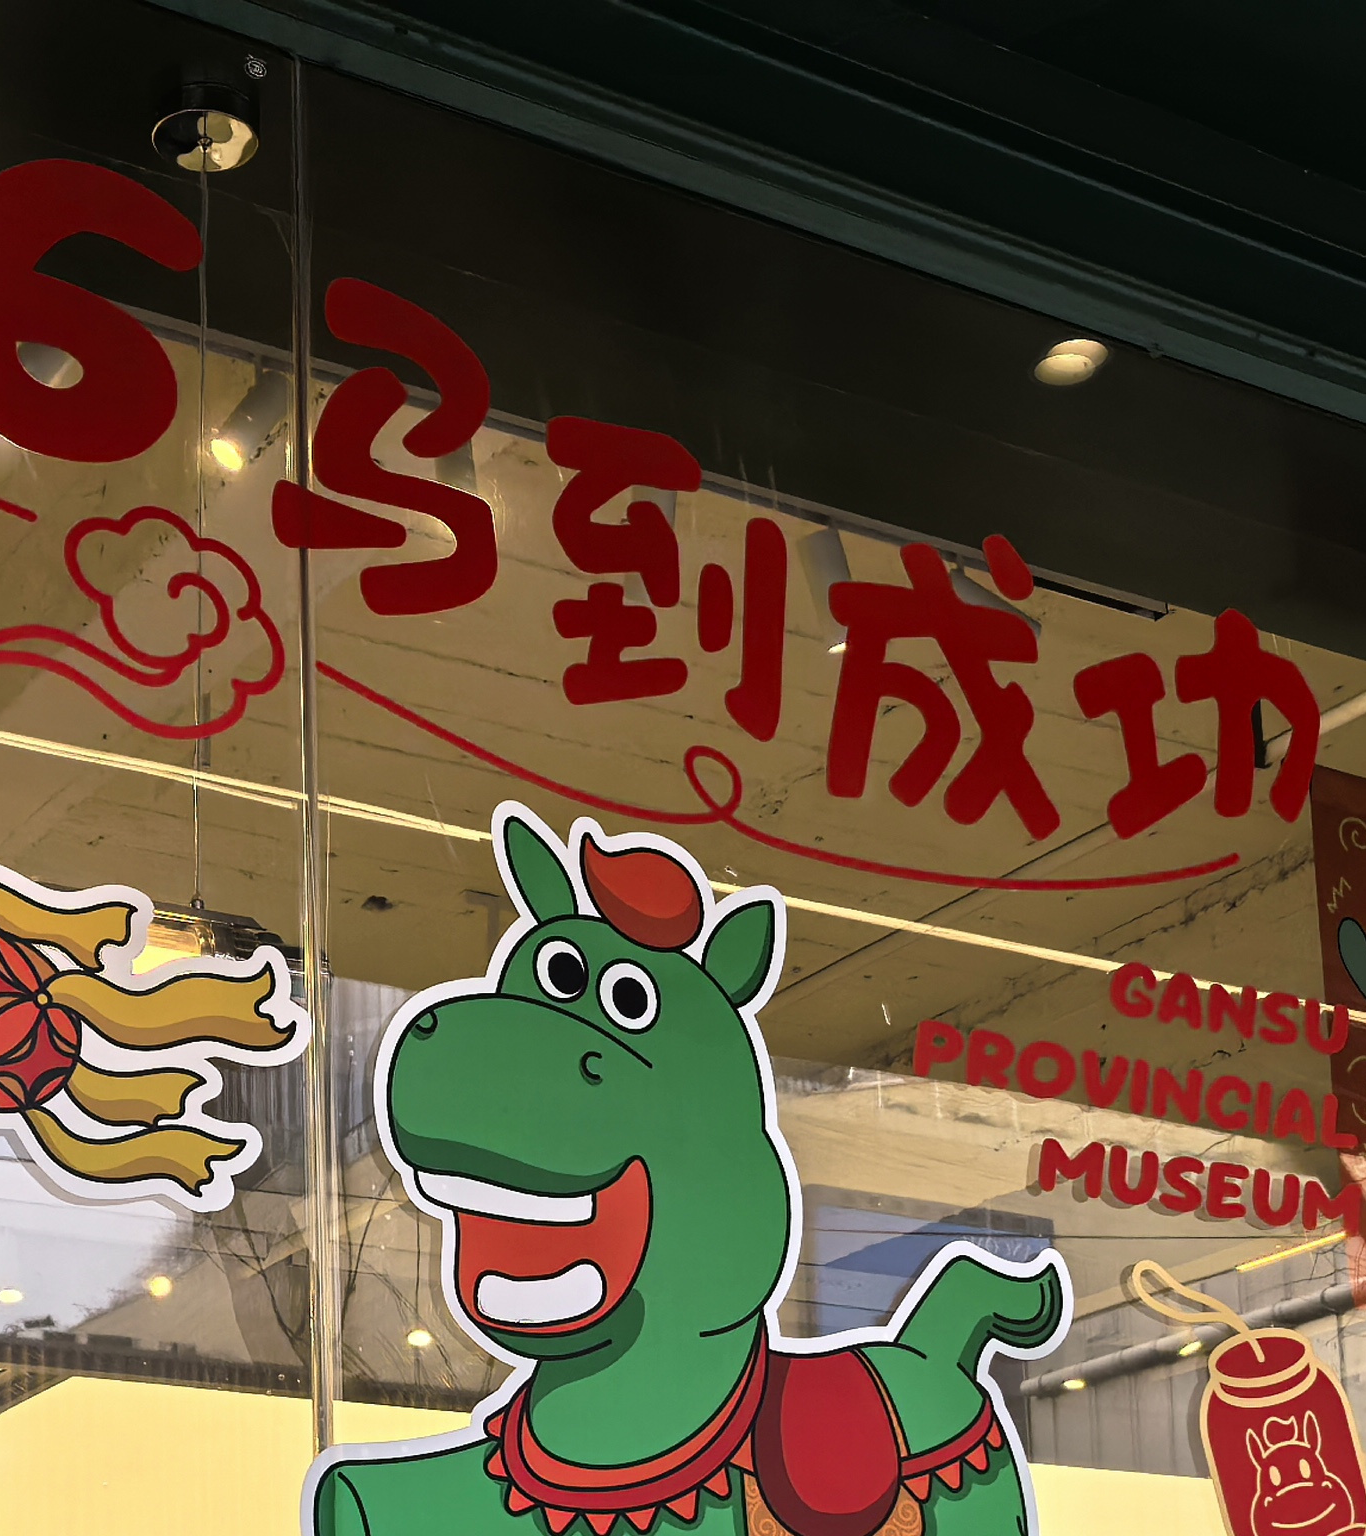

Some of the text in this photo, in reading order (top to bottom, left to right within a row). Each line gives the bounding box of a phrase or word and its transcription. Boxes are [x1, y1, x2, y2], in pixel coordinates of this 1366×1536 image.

[272, 277, 1320, 840] 马到成功
[1110, 961, 1349, 1055] GANSU
[913, 1020, 1359, 1149] PROVINCIAL
[1038, 1137, 1361, 1237] MUSEUM
